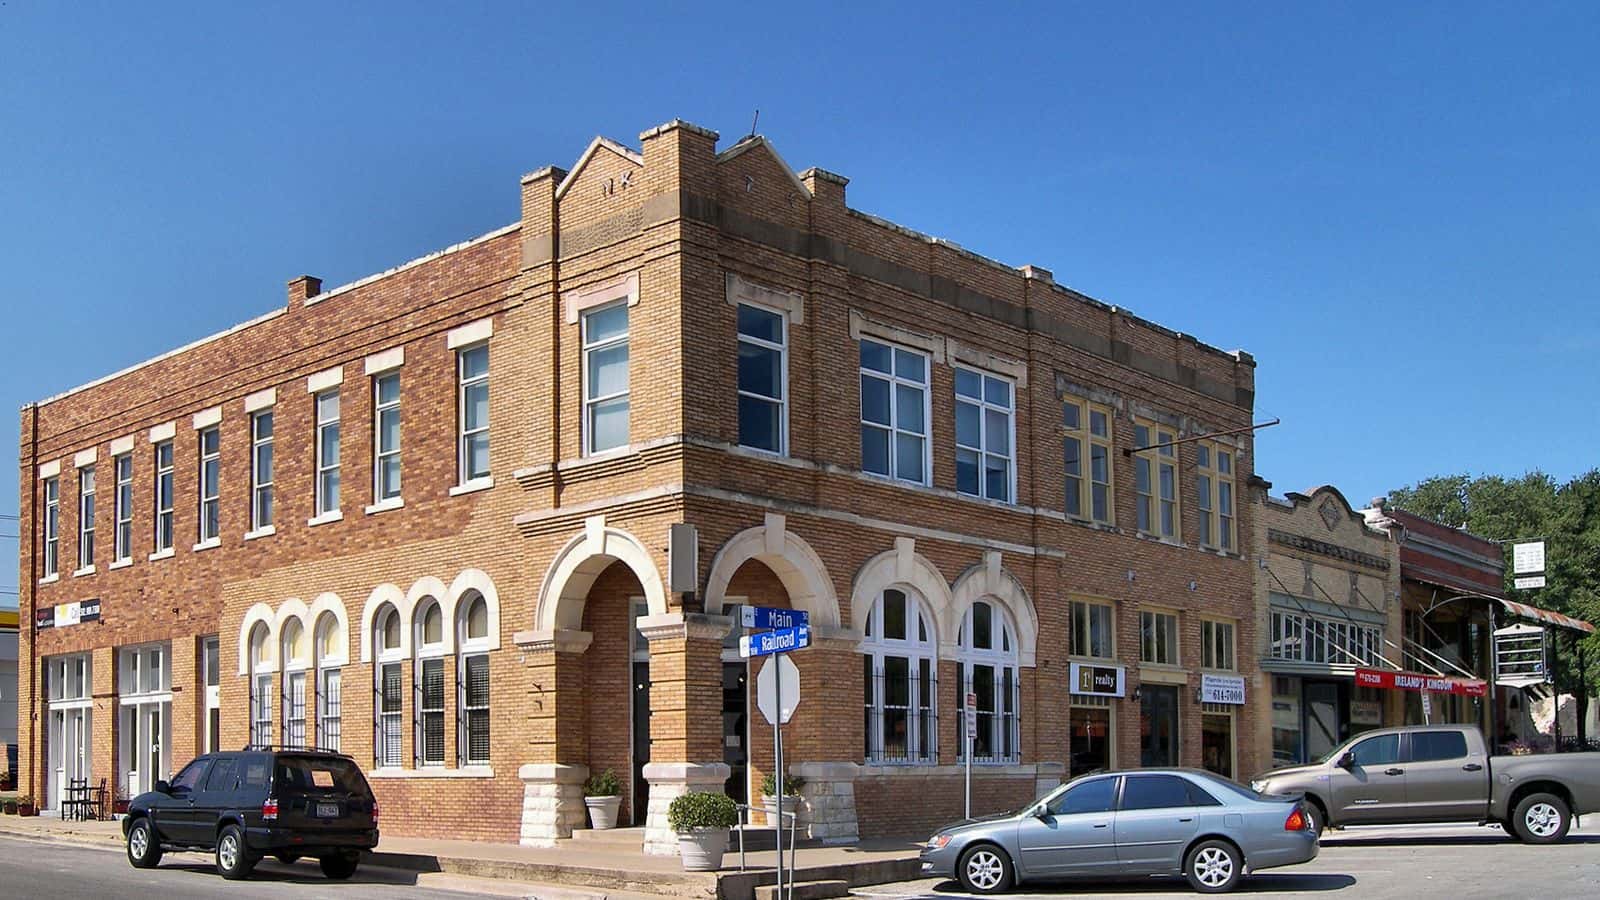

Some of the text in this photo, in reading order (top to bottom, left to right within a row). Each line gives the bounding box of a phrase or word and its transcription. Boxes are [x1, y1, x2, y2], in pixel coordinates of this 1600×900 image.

[768, 610, 793, 628] Main
[761, 630, 795, 651] Railroad
[1095, 673, 1115, 688] realty
[1212, 688, 1243, 701] 614-7000
